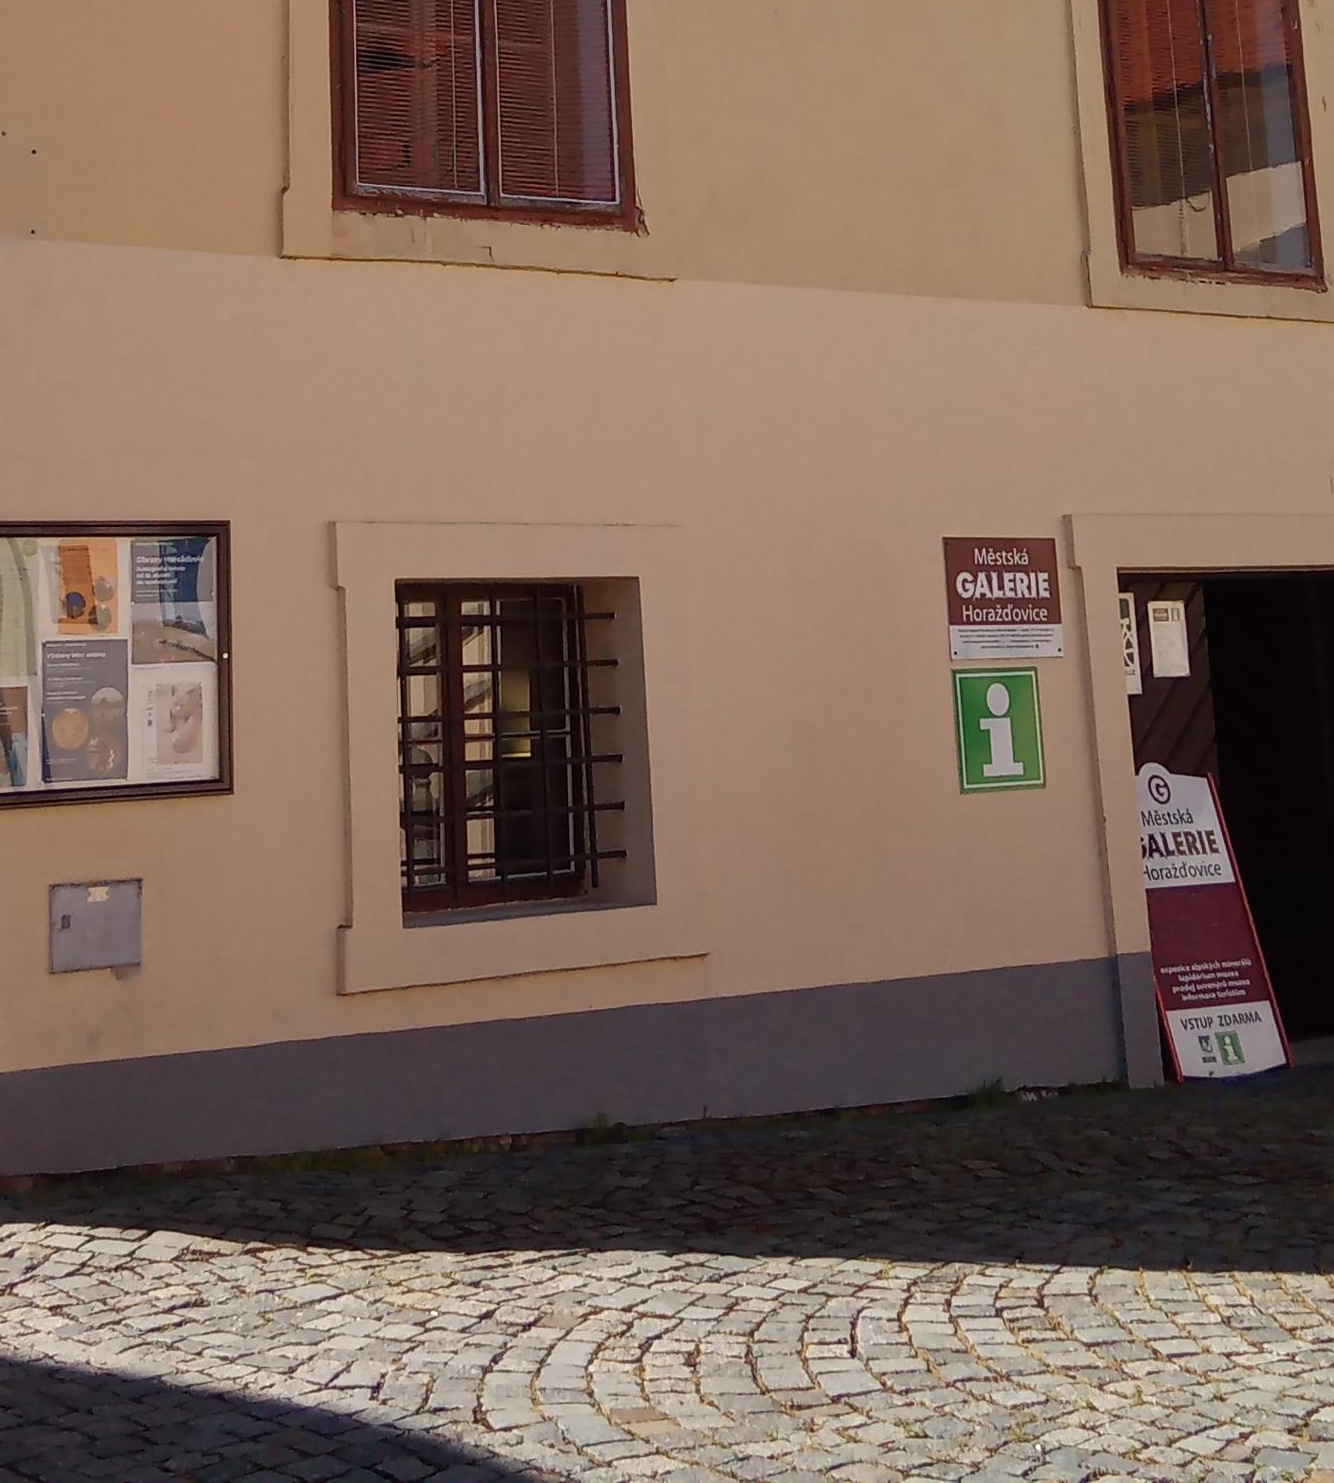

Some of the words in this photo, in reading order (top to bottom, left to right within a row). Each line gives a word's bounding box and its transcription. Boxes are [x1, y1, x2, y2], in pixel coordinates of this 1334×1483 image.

[974, 548, 1029, 566] Městská
[955, 572, 1051, 599] GALERIE
[962, 604, 1048, 623] Horažďovice
[1140, 808, 1194, 827] Městská
[1180, 1017, 1214, 1031] VSTUP
[1217, 1011, 1263, 1027] ZDARMA
